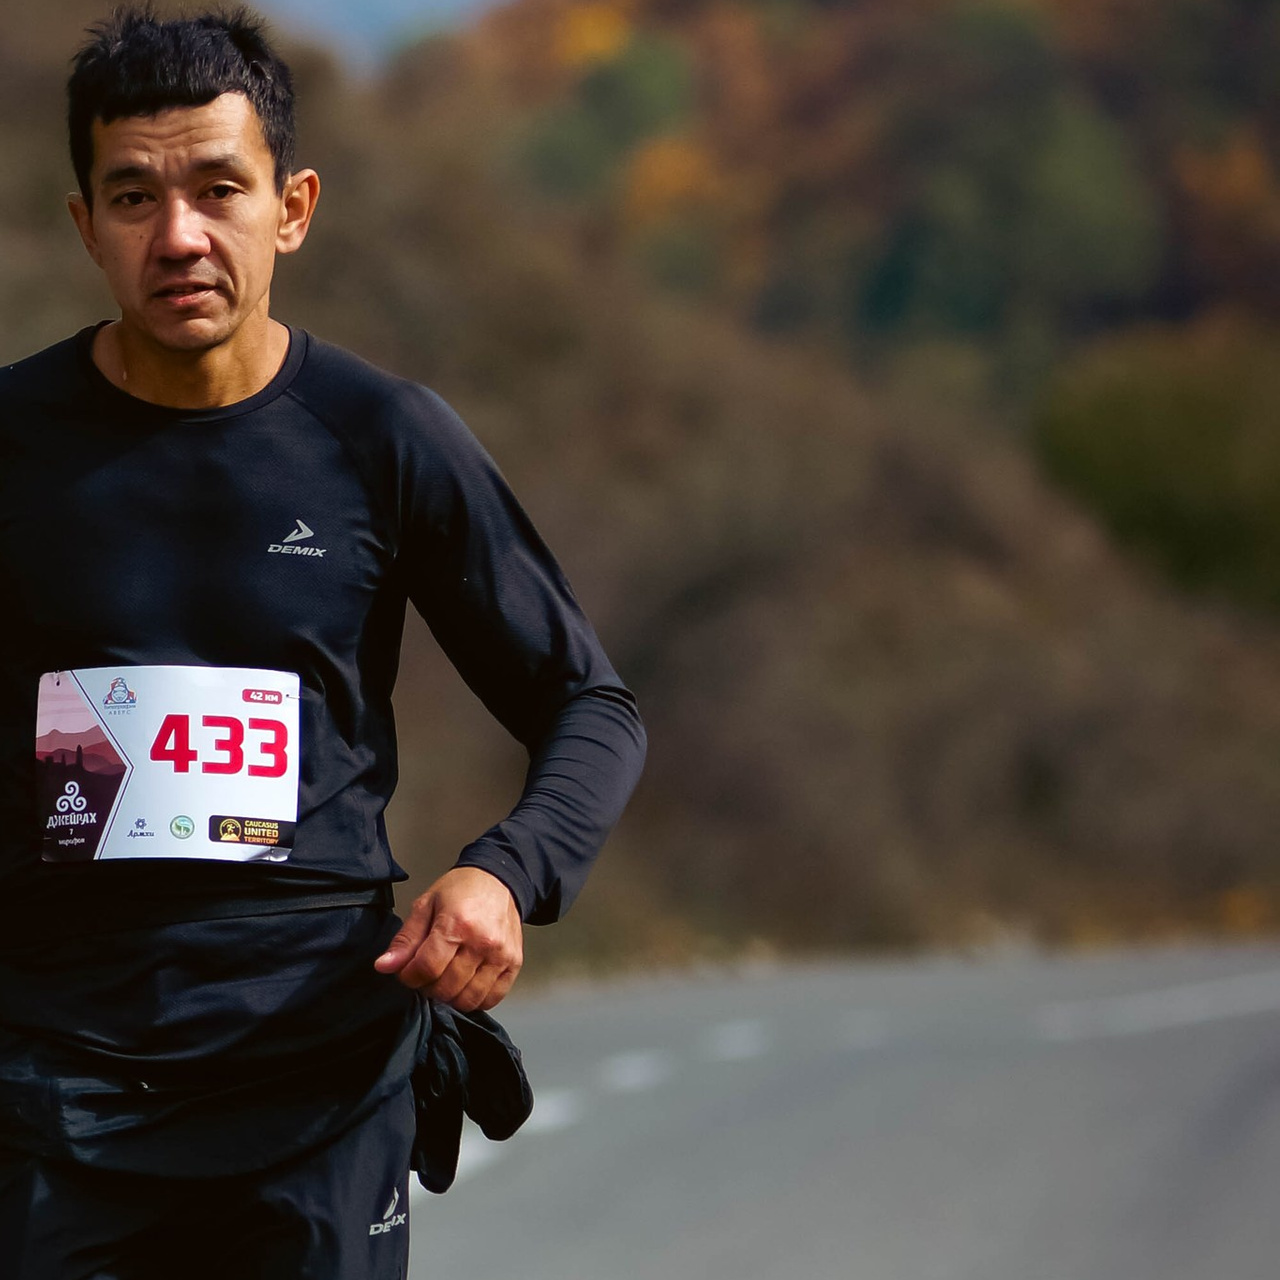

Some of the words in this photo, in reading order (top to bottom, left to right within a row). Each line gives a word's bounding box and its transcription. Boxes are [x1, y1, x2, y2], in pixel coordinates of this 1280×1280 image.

[267, 544, 327, 557] DEMIX
[250, 691, 263, 701] 42
[150, 714, 288, 778] 433
[46, 812, 97, 829] ДЖЕЙРАХ
[244, 820, 279, 829] CAUCASUS
[244, 827, 279, 838] UNITED
[244, 836, 279, 845] TERRITORY
